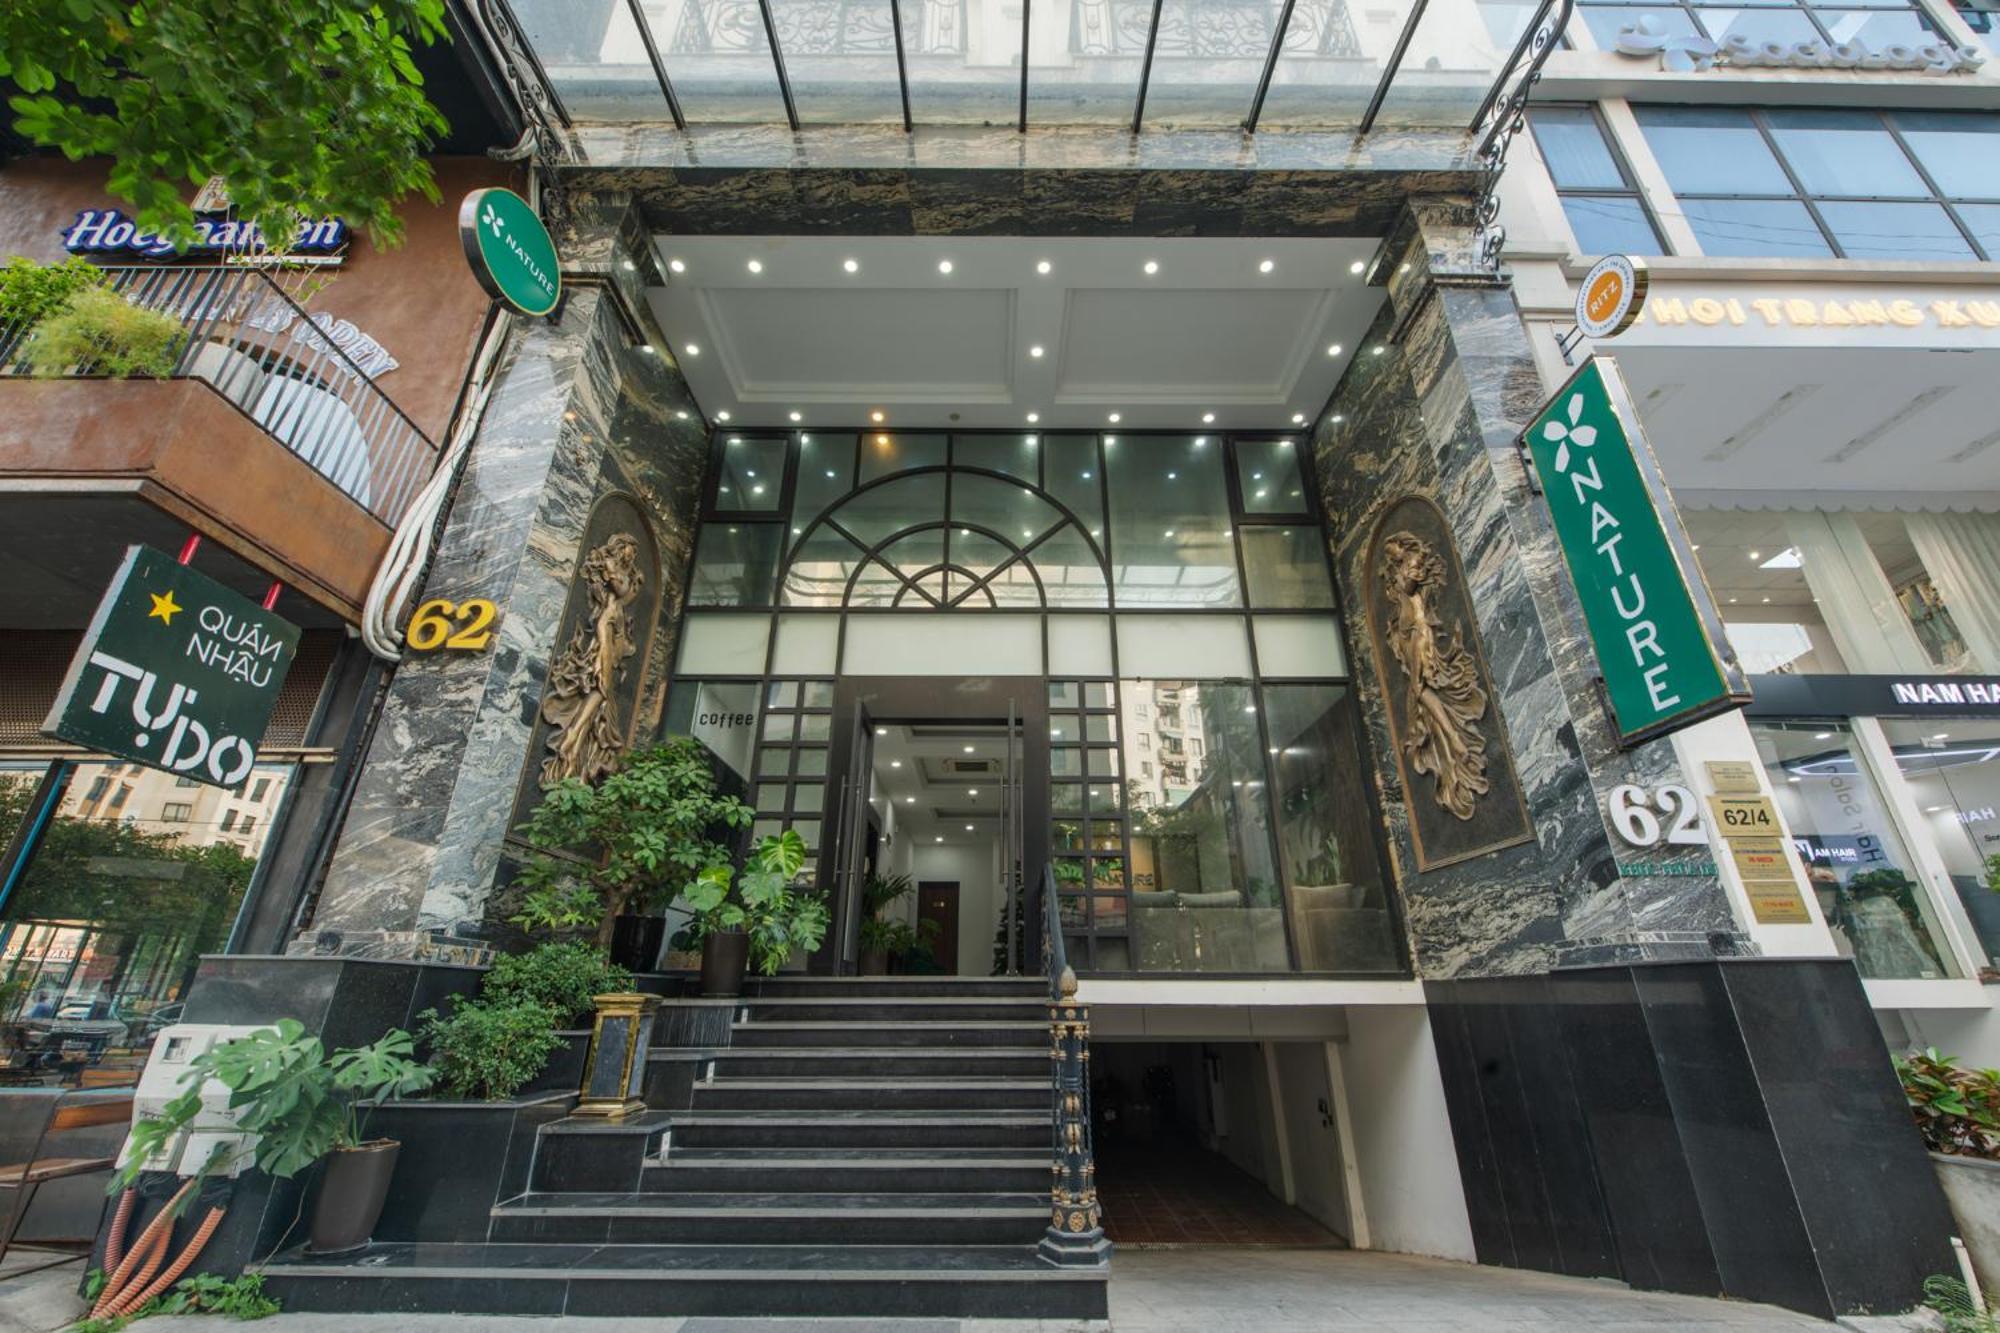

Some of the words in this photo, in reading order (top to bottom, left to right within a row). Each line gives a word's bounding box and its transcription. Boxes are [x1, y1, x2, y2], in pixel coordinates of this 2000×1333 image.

[505, 233, 555, 296] NATURE
[1590, 279, 1619, 315] RITZ
[1634, 297, 1747, 327] HOI
[1752, 298, 1925, 328] TRANG
[1570, 456, 1681, 713] NATURE
[407, 598, 497, 651] 62
[186, 633, 272, 687] NHẬU
[1893, 683, 1965, 704] NAM
[700, 713, 754, 728] coffee
[1609, 784, 1710, 846] 62
